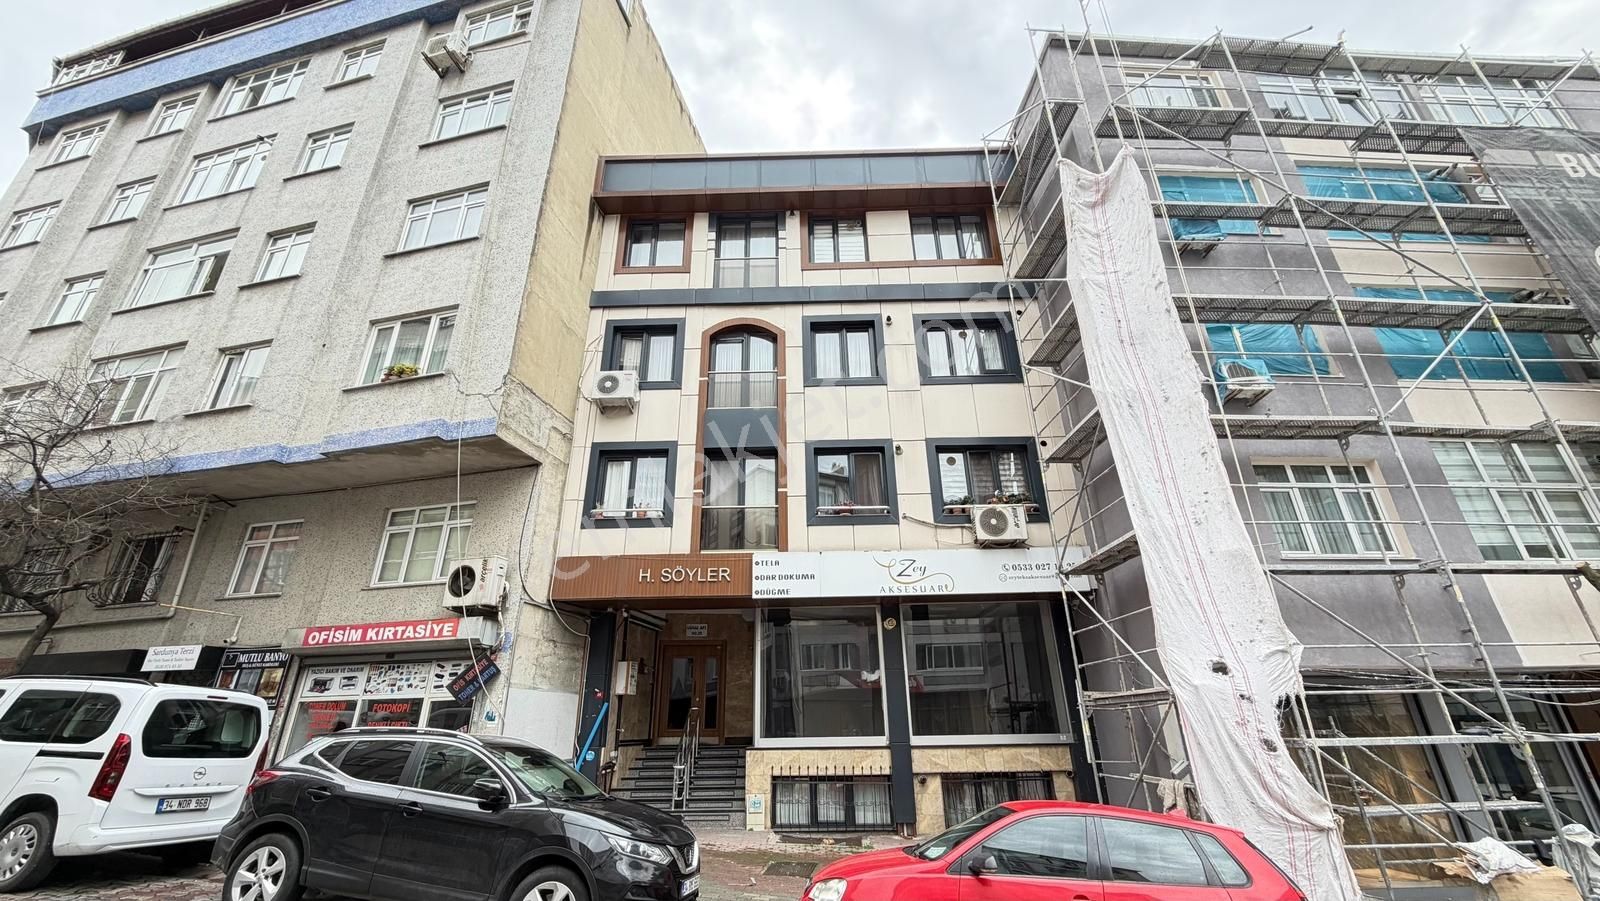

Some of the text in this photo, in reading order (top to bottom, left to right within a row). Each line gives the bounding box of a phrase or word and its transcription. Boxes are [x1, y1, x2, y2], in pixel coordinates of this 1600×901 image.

[761, 559, 780, 567] TELA
[896, 559, 926, 577] Zey
[1011, 563, 1033, 571] 0533
[1035, 562, 1051, 571] 027
[638, 565, 731, 583] H. SÖYLER
[880, 585, 945, 594] AKSESUAR
[307, 620, 454, 645] OFİSİM KIRTASİYE
[237, 652, 289, 663] MUTLU BANYO
[372, 702, 410, 713] FOTOKOPİ
[164, 800, 174, 810] 34
[195, 798, 209, 808] 968
